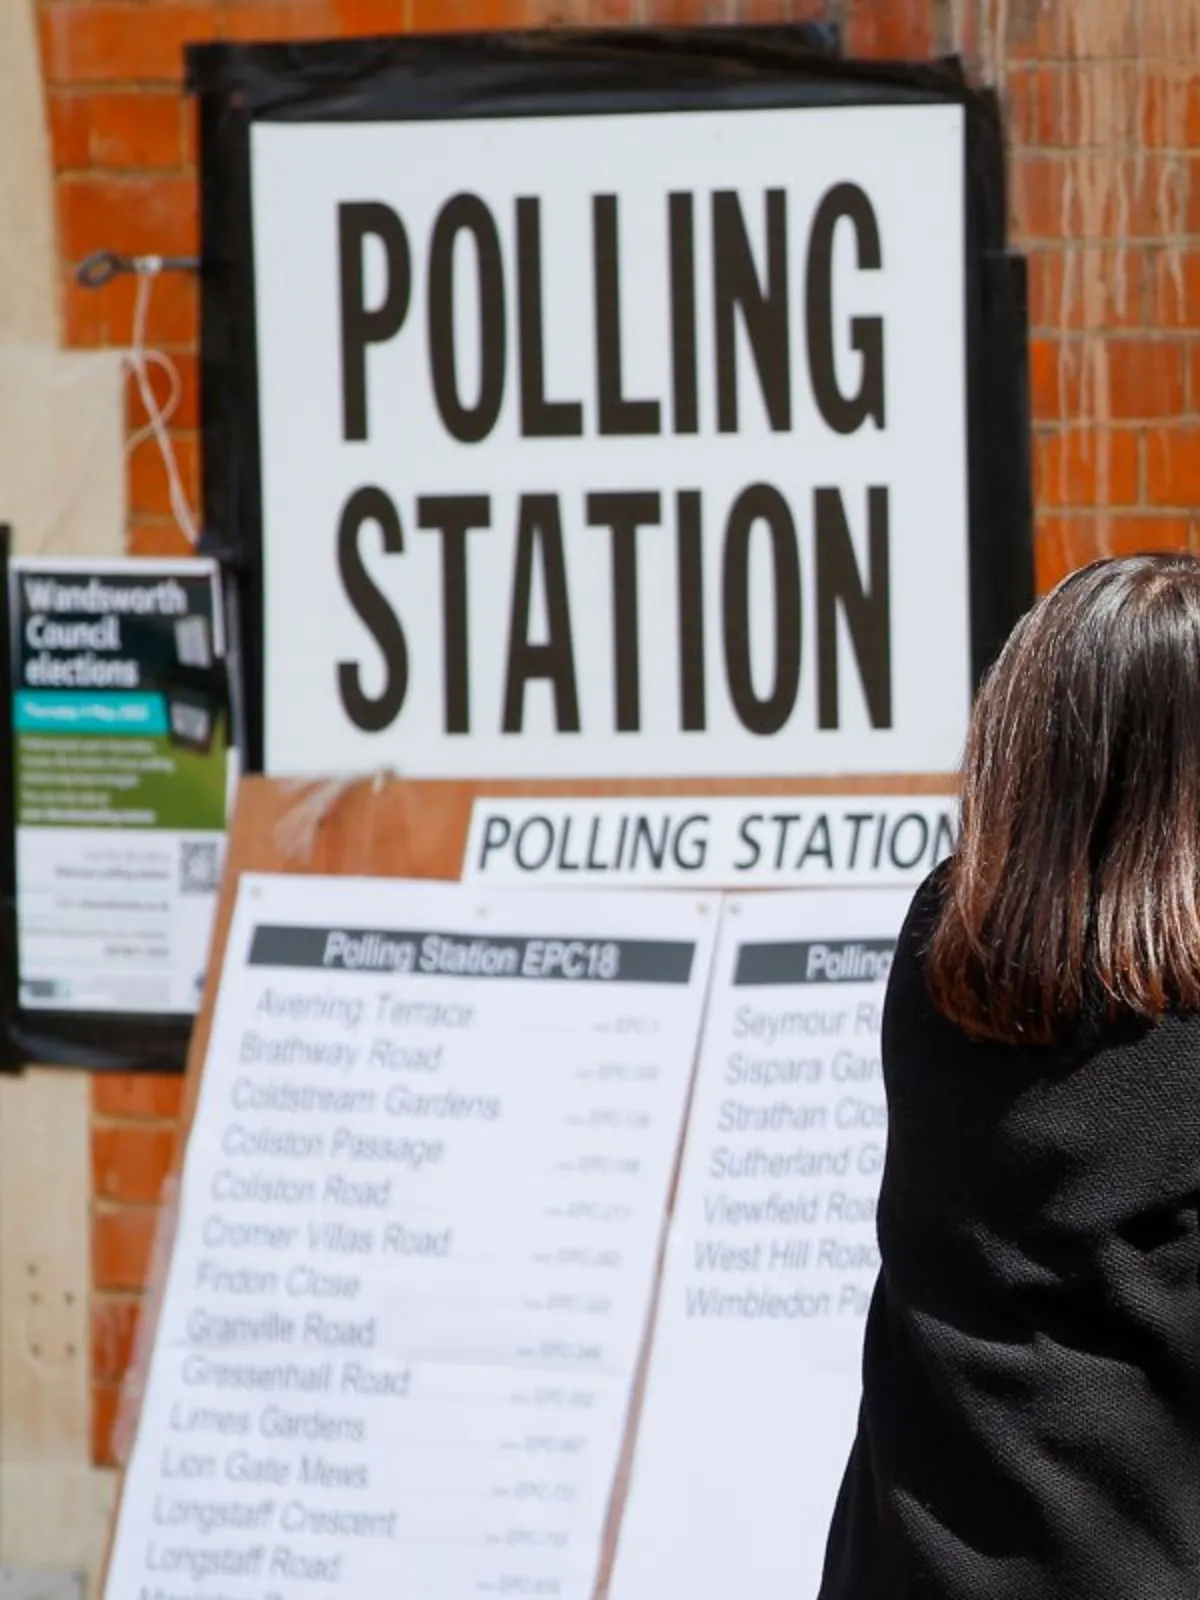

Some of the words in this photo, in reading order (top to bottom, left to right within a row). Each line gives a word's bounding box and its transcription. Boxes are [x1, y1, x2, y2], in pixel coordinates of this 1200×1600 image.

[335, 180, 890, 448] POLLING
[25, 578, 188, 614] Wandsworth
[333, 480, 896, 740] STATION
[26, 614, 120, 650] Council
[26, 652, 140, 688] elections
[479, 814, 710, 872] POLLING
[733, 812, 961, 870] STATION
[323, 930, 413, 972] Polling
[419, 935, 518, 974] Station
[522, 941, 619, 979] EPC18
[256, 988, 365, 1026] Avening
[375, 995, 475, 1028] Terrace
[732, 1002, 847, 1044] Seymour
[239, 1032, 359, 1072] Brathway
[368, 1038, 444, 1072] Road
[231, 1078, 376, 1113] Coldstream
[385, 1084, 501, 1123] Gardens
[331, 1128, 444, 1170] Passage
[708, 1144, 851, 1180] Sutherland
[322, 1173, 391, 1208] Road
[702, 1190, 820, 1226] Viewfield
[307, 1218, 377, 1255] Villas
[384, 1224, 452, 1258] Road
[694, 1239, 762, 1273] West
[767, 1238, 810, 1271] Hill
[285, 1264, 360, 1300] Close
[684, 1287, 831, 1320] Wimbledon
[185, 1307, 295, 1344] Granville
[302, 1311, 376, 1349] Road
[340, 1361, 410, 1398] Road
[259, 1405, 366, 1441] Gardens
[161, 1446, 216, 1480] Lion
[224, 1450, 290, 1486] Gate
[297, 1454, 370, 1490] Mews
[152, 1494, 273, 1534] Longstaff
[279, 1499, 398, 1538] Crescent
[144, 1541, 264, 1581] Longstaff
[269, 1545, 343, 1581] Road
